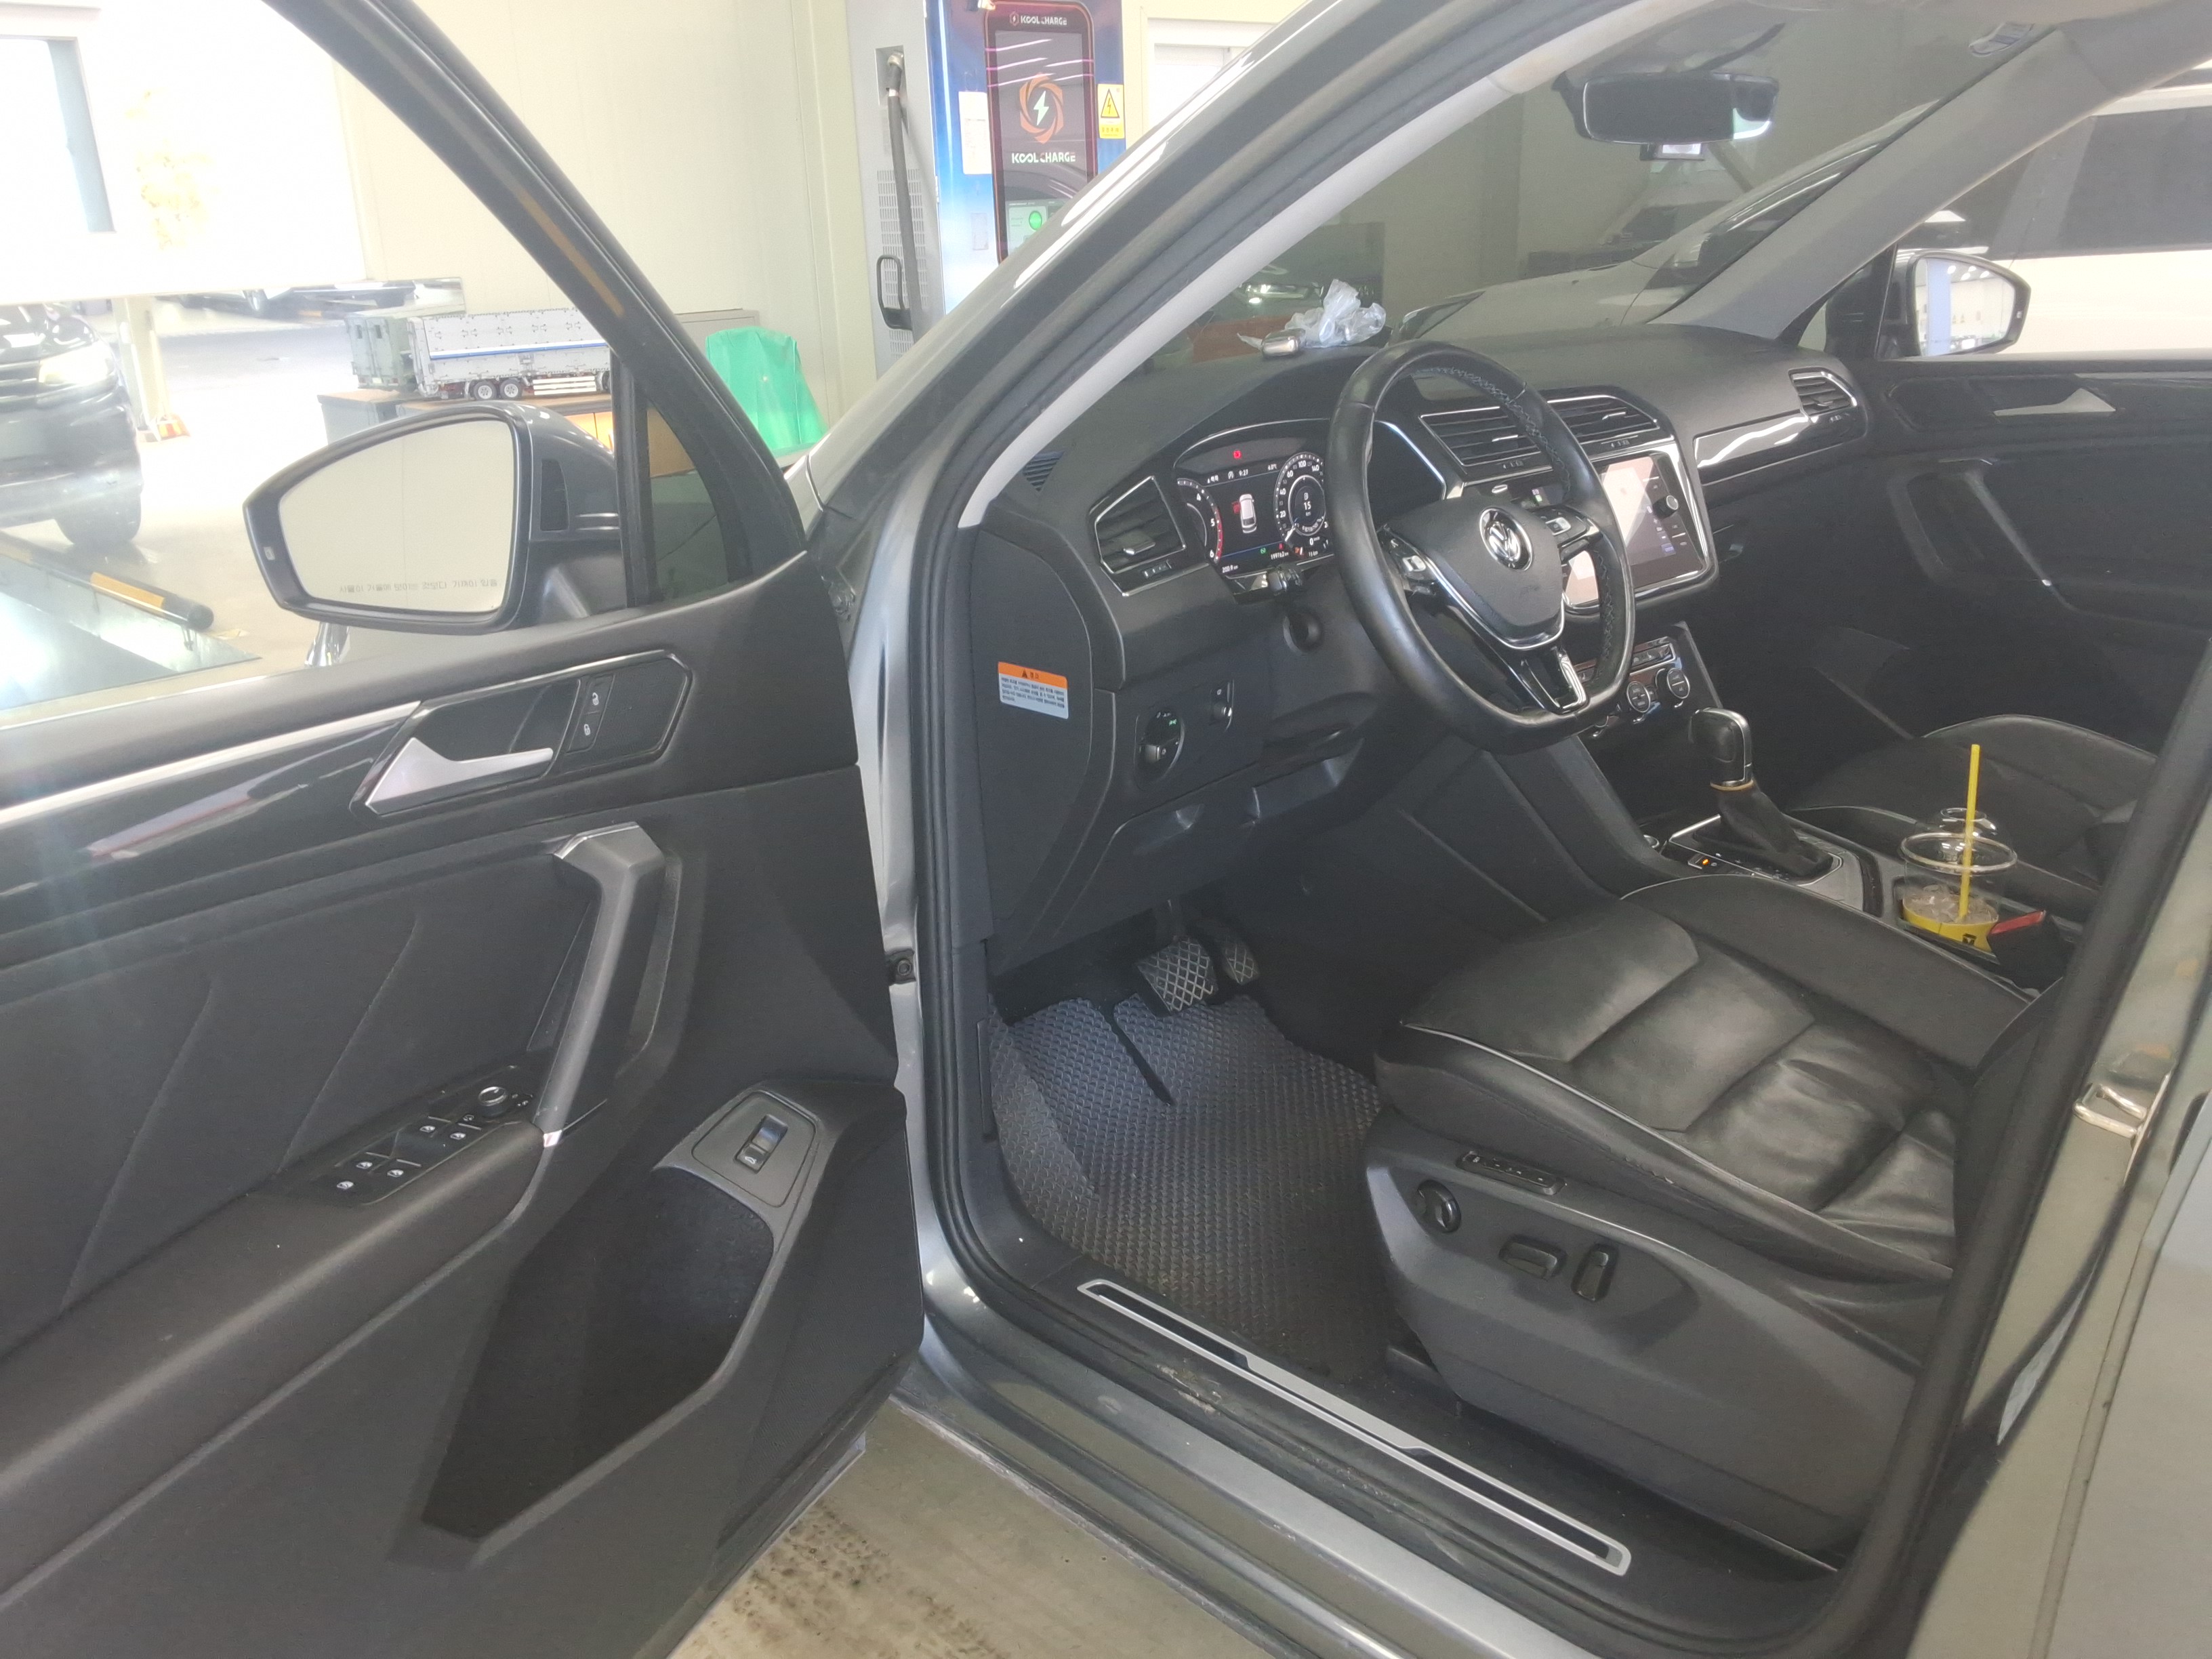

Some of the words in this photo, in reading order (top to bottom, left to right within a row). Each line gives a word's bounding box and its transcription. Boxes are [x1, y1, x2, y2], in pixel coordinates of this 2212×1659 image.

[1021, 16, 1040, 24] KOOL
[1011, 152, 1039, 163] KOOL
[1040, 152, 1076, 163] CHARGE
[1303, 501, 1311, 510] 15
[1279, 510, 1286, 518] 20
[1210, 518, 1215, 527] 5
[1210, 549, 1214, 558] 6
